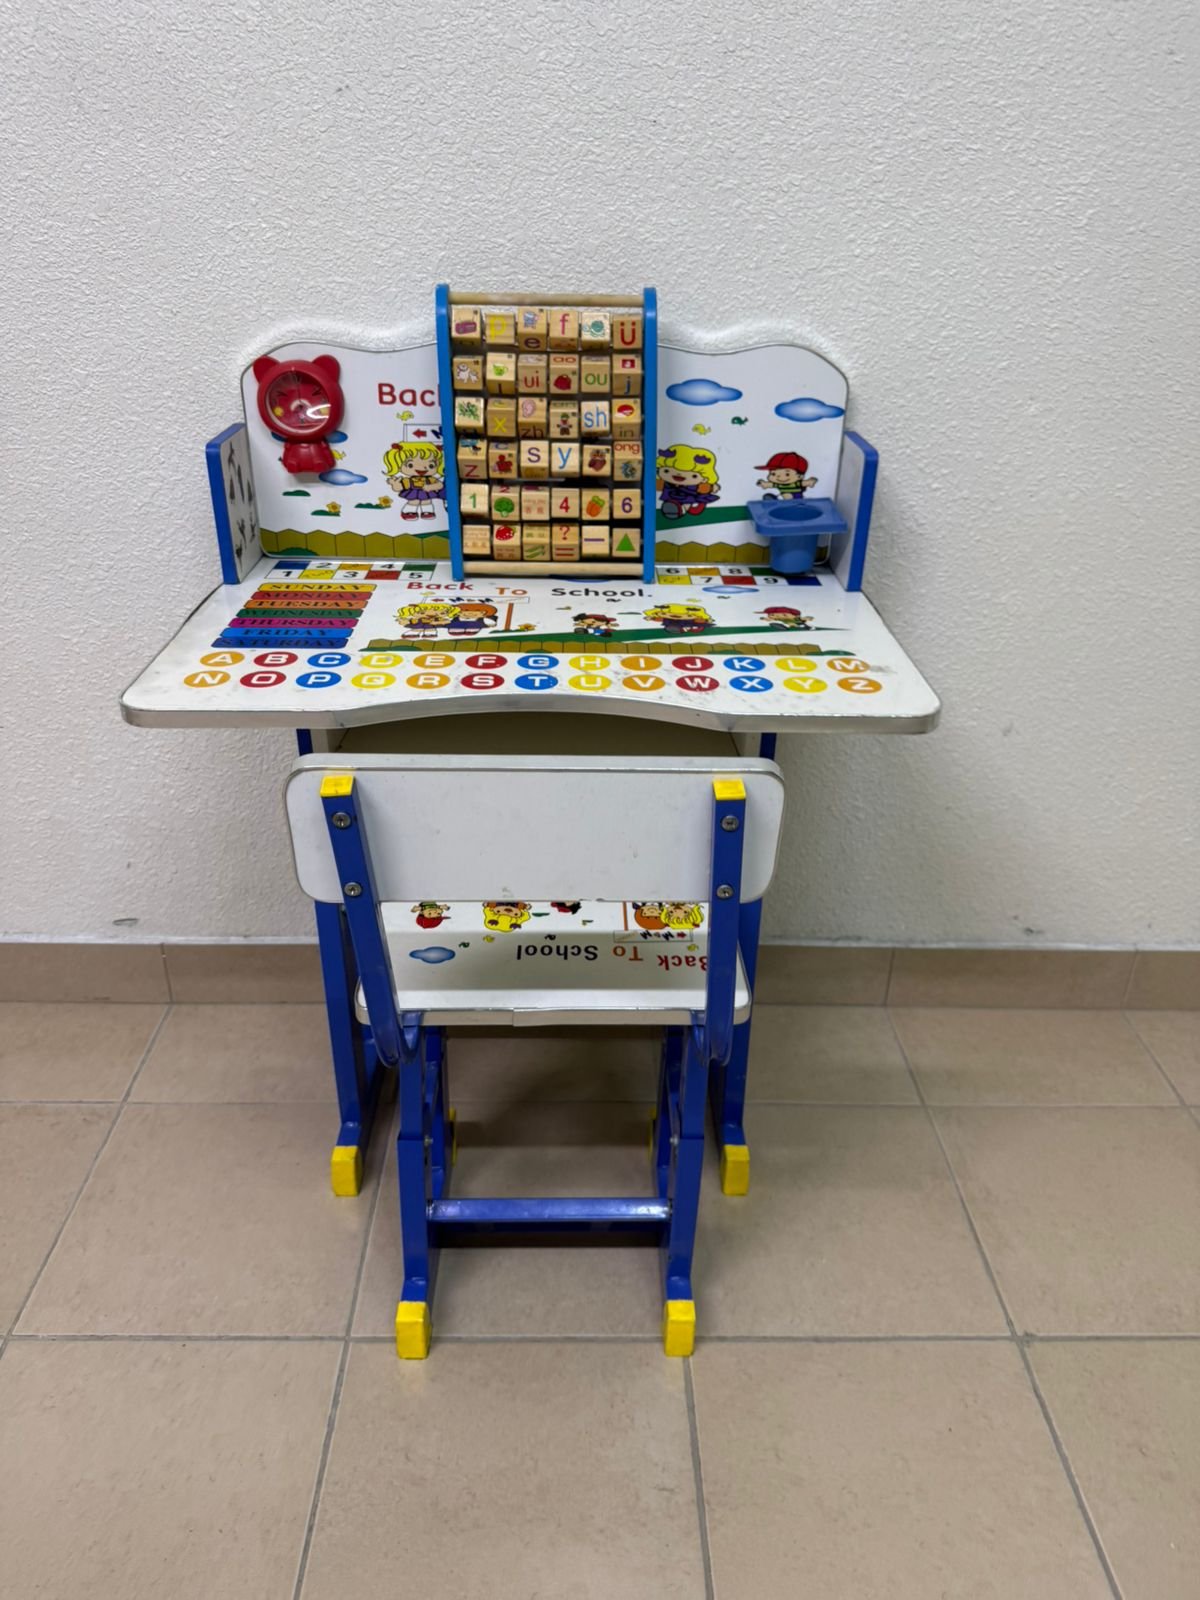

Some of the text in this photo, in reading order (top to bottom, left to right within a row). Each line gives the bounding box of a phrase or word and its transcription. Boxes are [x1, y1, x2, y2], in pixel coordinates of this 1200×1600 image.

[559, 312, 570, 336] f
[523, 336, 541, 349] e
[523, 370, 540, 388] ui
[584, 372, 608, 386] ou
[377, 382, 441, 407] Bac
[583, 405, 607, 429] sh
[614, 443, 640, 455] ong
[469, 492, 477, 509] 1
[559, 495, 570, 513] 4
[621, 496, 633, 514] 6
[559, 525, 571, 541] ?
[270, 583, 366, 591] SUNDAY
[764, 576, 779, 584] 9
[261, 591, 361, 599] MONDAY
[407, 581, 474, 591] Back
[495, 586, 528, 596] To
[254, 600, 361, 608] TUESDAY
[244, 609, 355, 617] WEDNESDAY
[238, 618, 352, 626] THURSDAY
[243, 628, 333, 636] FRIDAY
[219, 638, 342, 647] SATURDAY
[208, 653, 233, 664] A
[263, 654, 289, 664] B
[317, 654, 342, 665] C
[370, 655, 393, 665] D
[425, 656, 444, 666] E
[477, 656, 497, 667] F
[528, 656, 549, 667] G
[580, 657, 601, 668] H
[684, 658, 702, 669] J
[731, 658, 754, 670] K
[787, 659, 807, 670] L
[832, 659, 865, 671] M
[193, 673, 875, 691] N O P Q R S T U V W X Y Z
[517, 944, 599, 961] School
[612, 945, 644, 962] To
